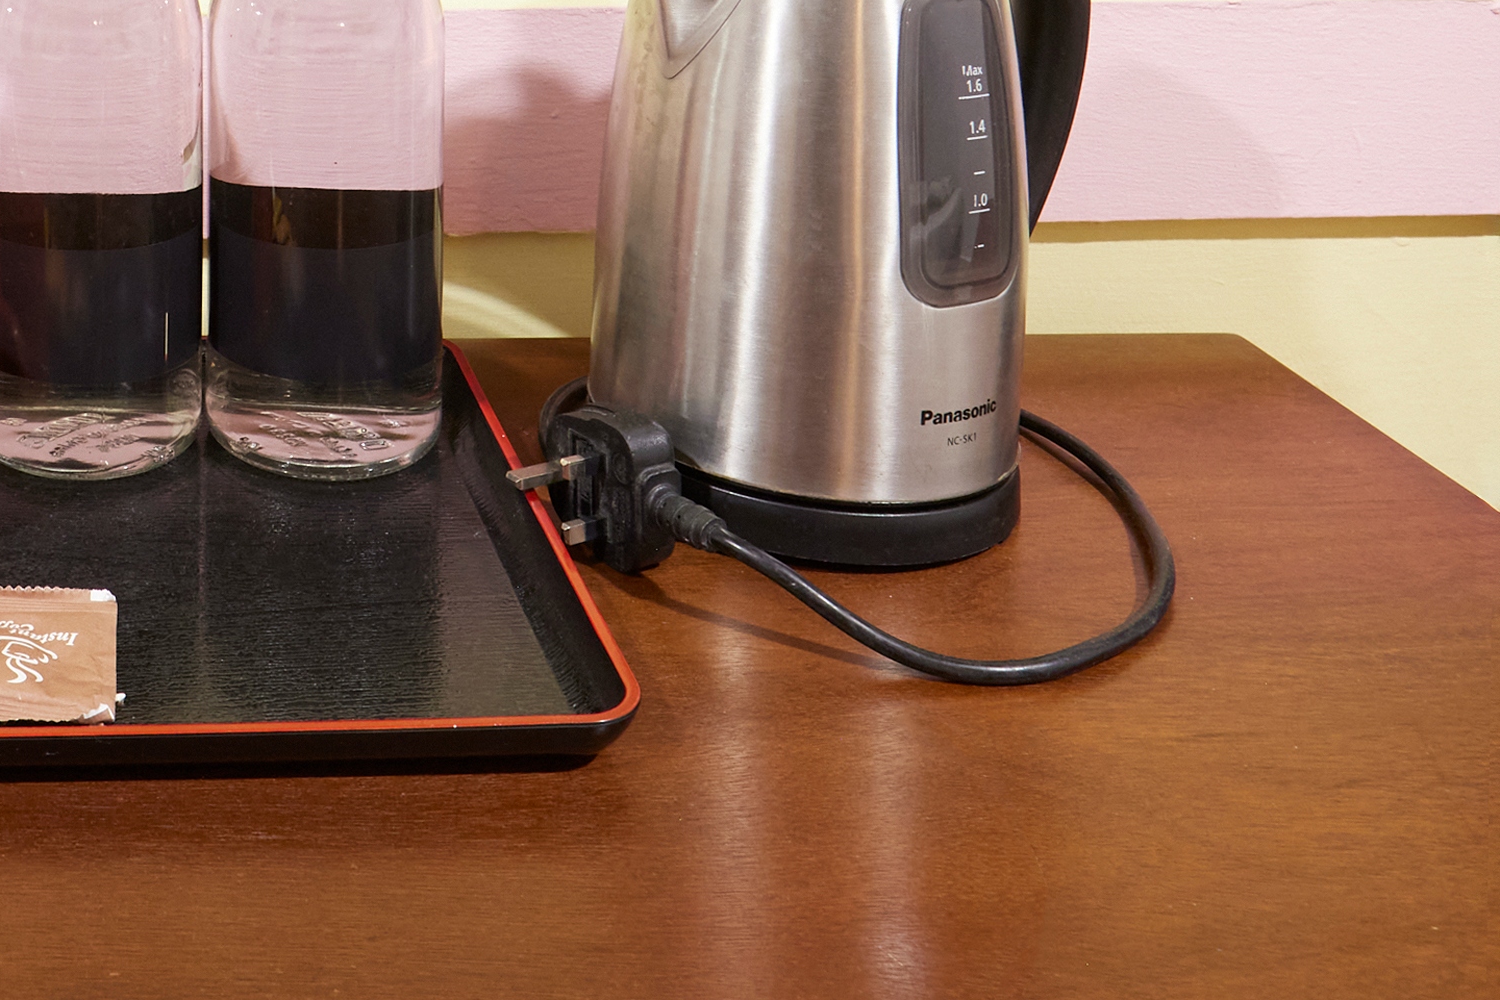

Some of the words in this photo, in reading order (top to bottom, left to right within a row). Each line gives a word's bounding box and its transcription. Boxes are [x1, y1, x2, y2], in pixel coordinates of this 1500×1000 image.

[962, 65, 983, 76] Max
[966, 79, 982, 93] 1.6
[969, 119, 986, 134] 1.4
[973, 193, 988, 207] 1.0
[920, 398, 997, 426] Panasonic
[947, 432, 977, 446] NC-SK1
[9, 629, 79, 647] Instant
